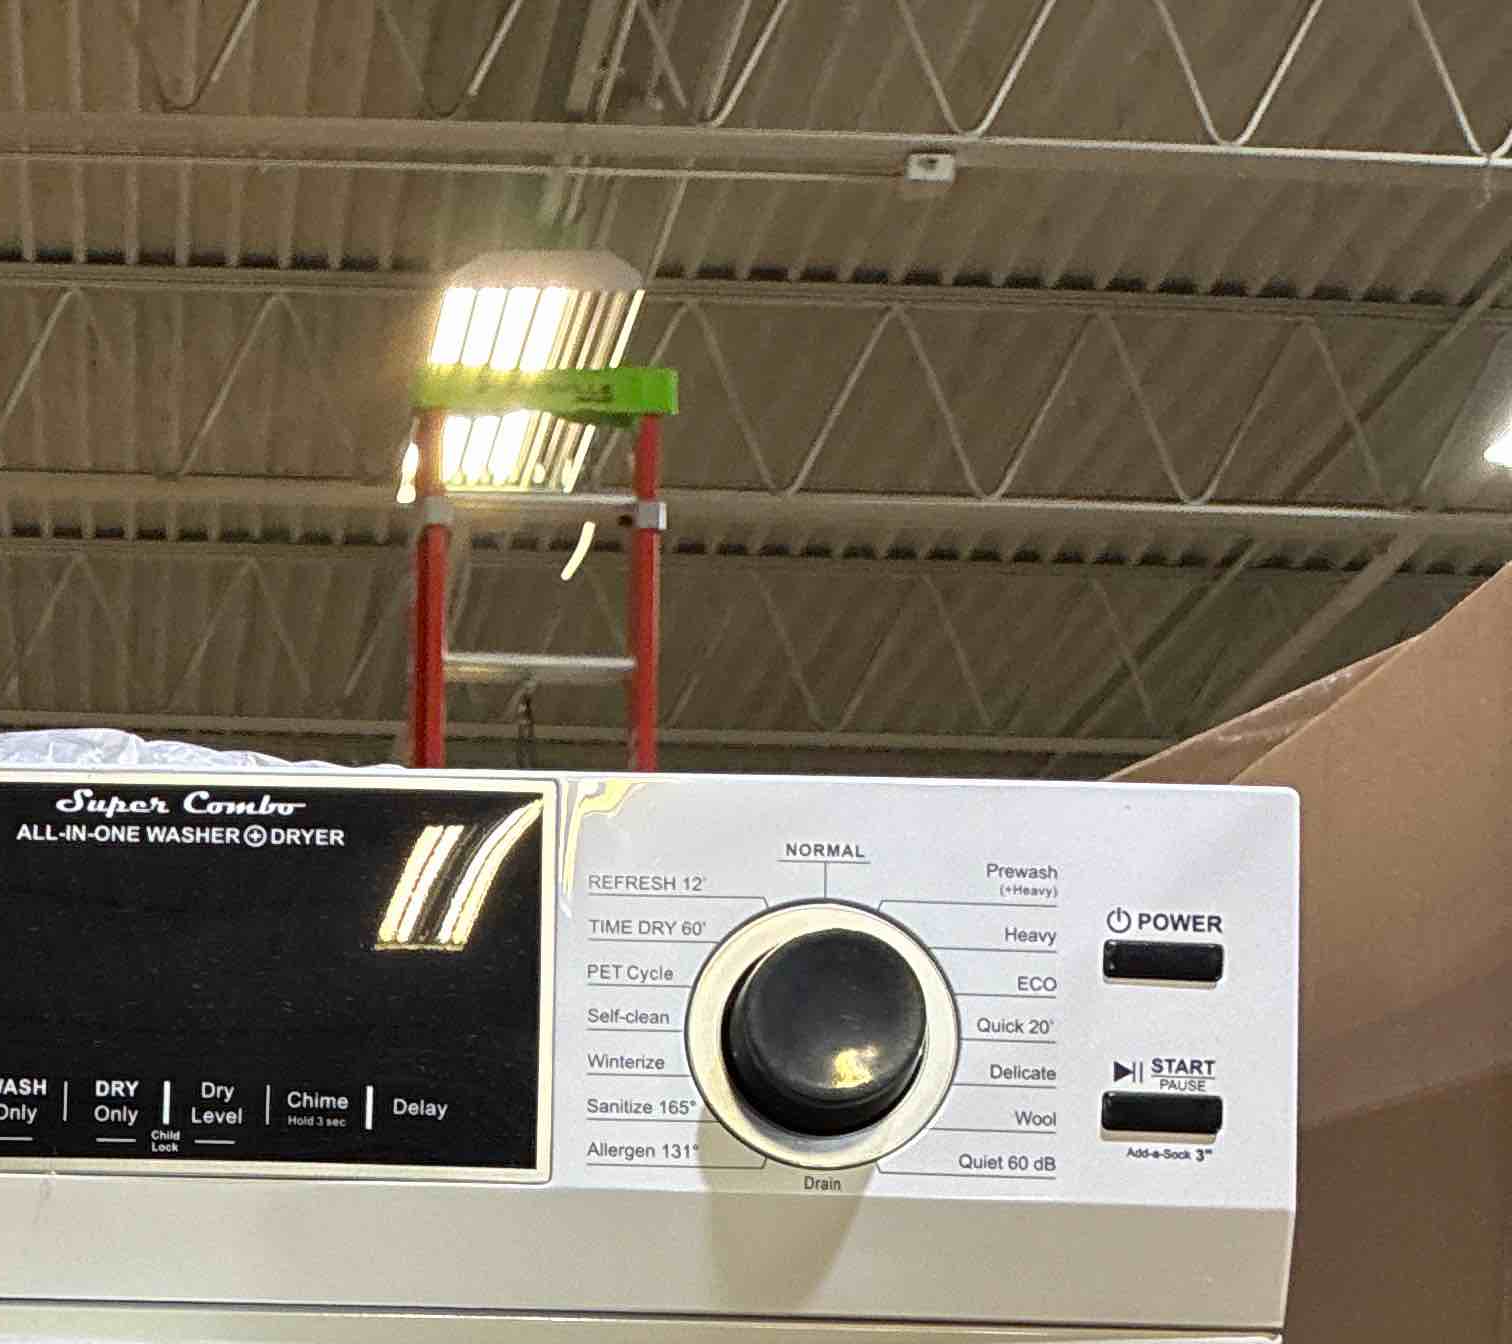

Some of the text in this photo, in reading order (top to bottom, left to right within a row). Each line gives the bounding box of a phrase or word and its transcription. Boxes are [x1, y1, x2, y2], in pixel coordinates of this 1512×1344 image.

[55, 788, 307, 818] Super Combo
[16, 823, 345, 846] ALL-IN-ONE WASHER DRYER
[785, 843, 865, 858] NORMAL
[986, 863, 1058, 880] Prewash
[588, 875, 677, 892] REFRESH
[999, 885, 1058, 898] (+Heavy)
[589, 919, 633, 935] TIME
[638, 920, 677, 936] DRY
[1138, 912, 1223, 933] POWER
[1004, 927, 1057, 946] Heavy
[587, 964, 673, 983] PET Cycle
[1017, 976, 1057, 992] ECO
[587, 1008, 670, 1025] Self-clean
[976, 1017, 1025, 1034] Quick
[587, 1053, 665, 1070] Winterize
[1150, 1058, 1216, 1077] START
[990, 1063, 1057, 1081] Delicate
[95, 1080, 139, 1097] DRY
[201, 1081, 235, 1102] Dry
[1159, 1078, 1207, 1092] PAUSE
[287, 1091, 349, 1110] Chime
[586, 1099, 653, 1115] Sanitize
[94, 1104, 138, 1126] Only
[191, 1107, 242, 1125] Level
[392, 1098, 448, 1121] Delay
[288, 1114, 346, 1127] Hold 3 sec
[1014, 1111, 1057, 1127] Wool
[151, 1130, 180, 1141] Child
[151, 1141, 178, 1152] Lock
[586, 1141, 656, 1160] Allergen
[958, 1153, 1057, 1171] Quiet 60 dB
[803, 1175, 841, 1191] Drain
